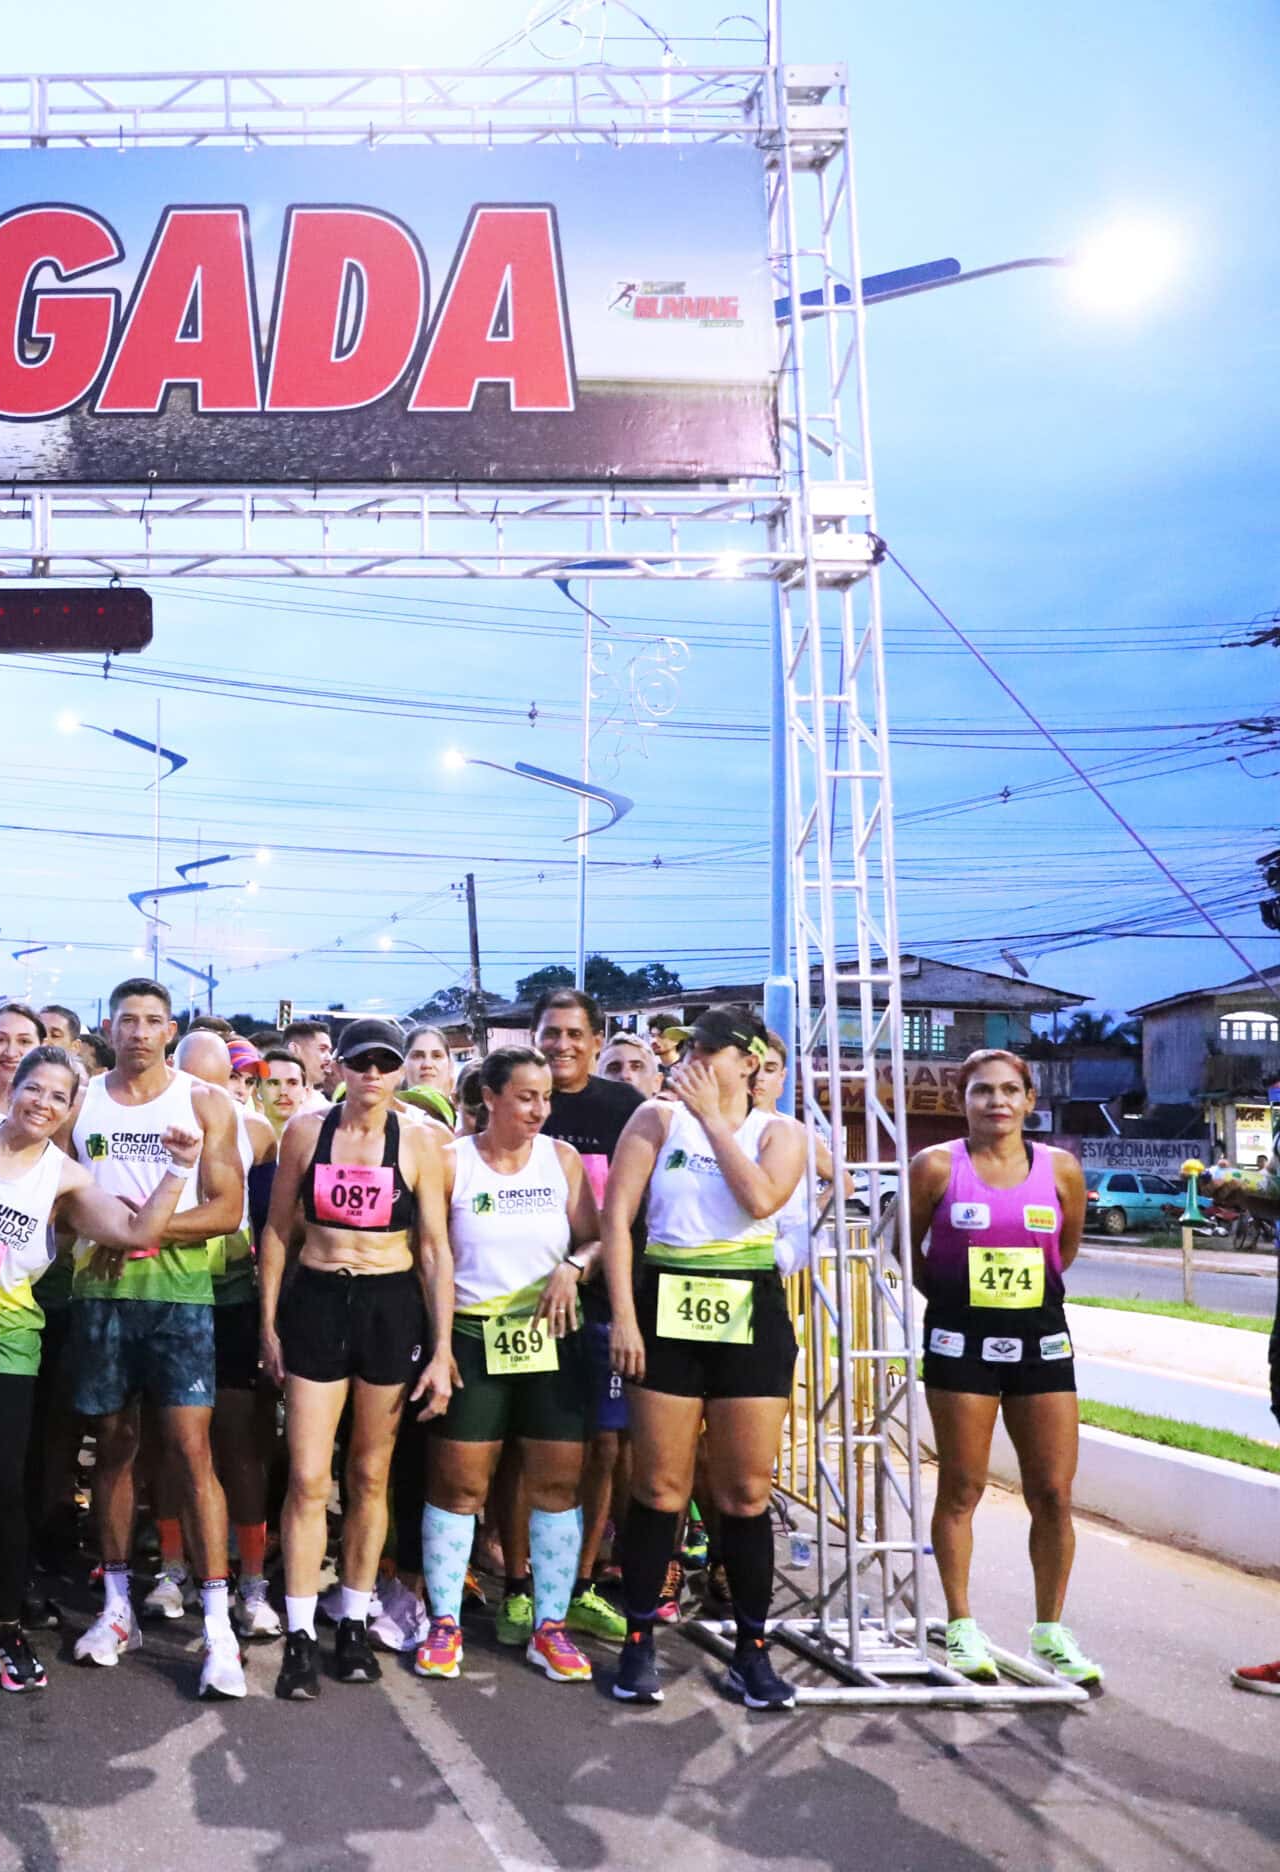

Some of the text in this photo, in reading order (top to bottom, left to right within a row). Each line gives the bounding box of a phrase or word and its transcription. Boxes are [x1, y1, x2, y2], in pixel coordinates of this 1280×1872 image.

[111, 1132, 161, 1144] CIRCUIT
[1081, 1142, 1202, 1159] ESTACIONAMENTO
[331, 1184, 382, 1210] 087
[497, 1187, 552, 1200] CIRCUITO
[979, 1267, 1033, 1291] 474
[676, 1296, 731, 1325] 468
[493, 1329, 544, 1355] 469
